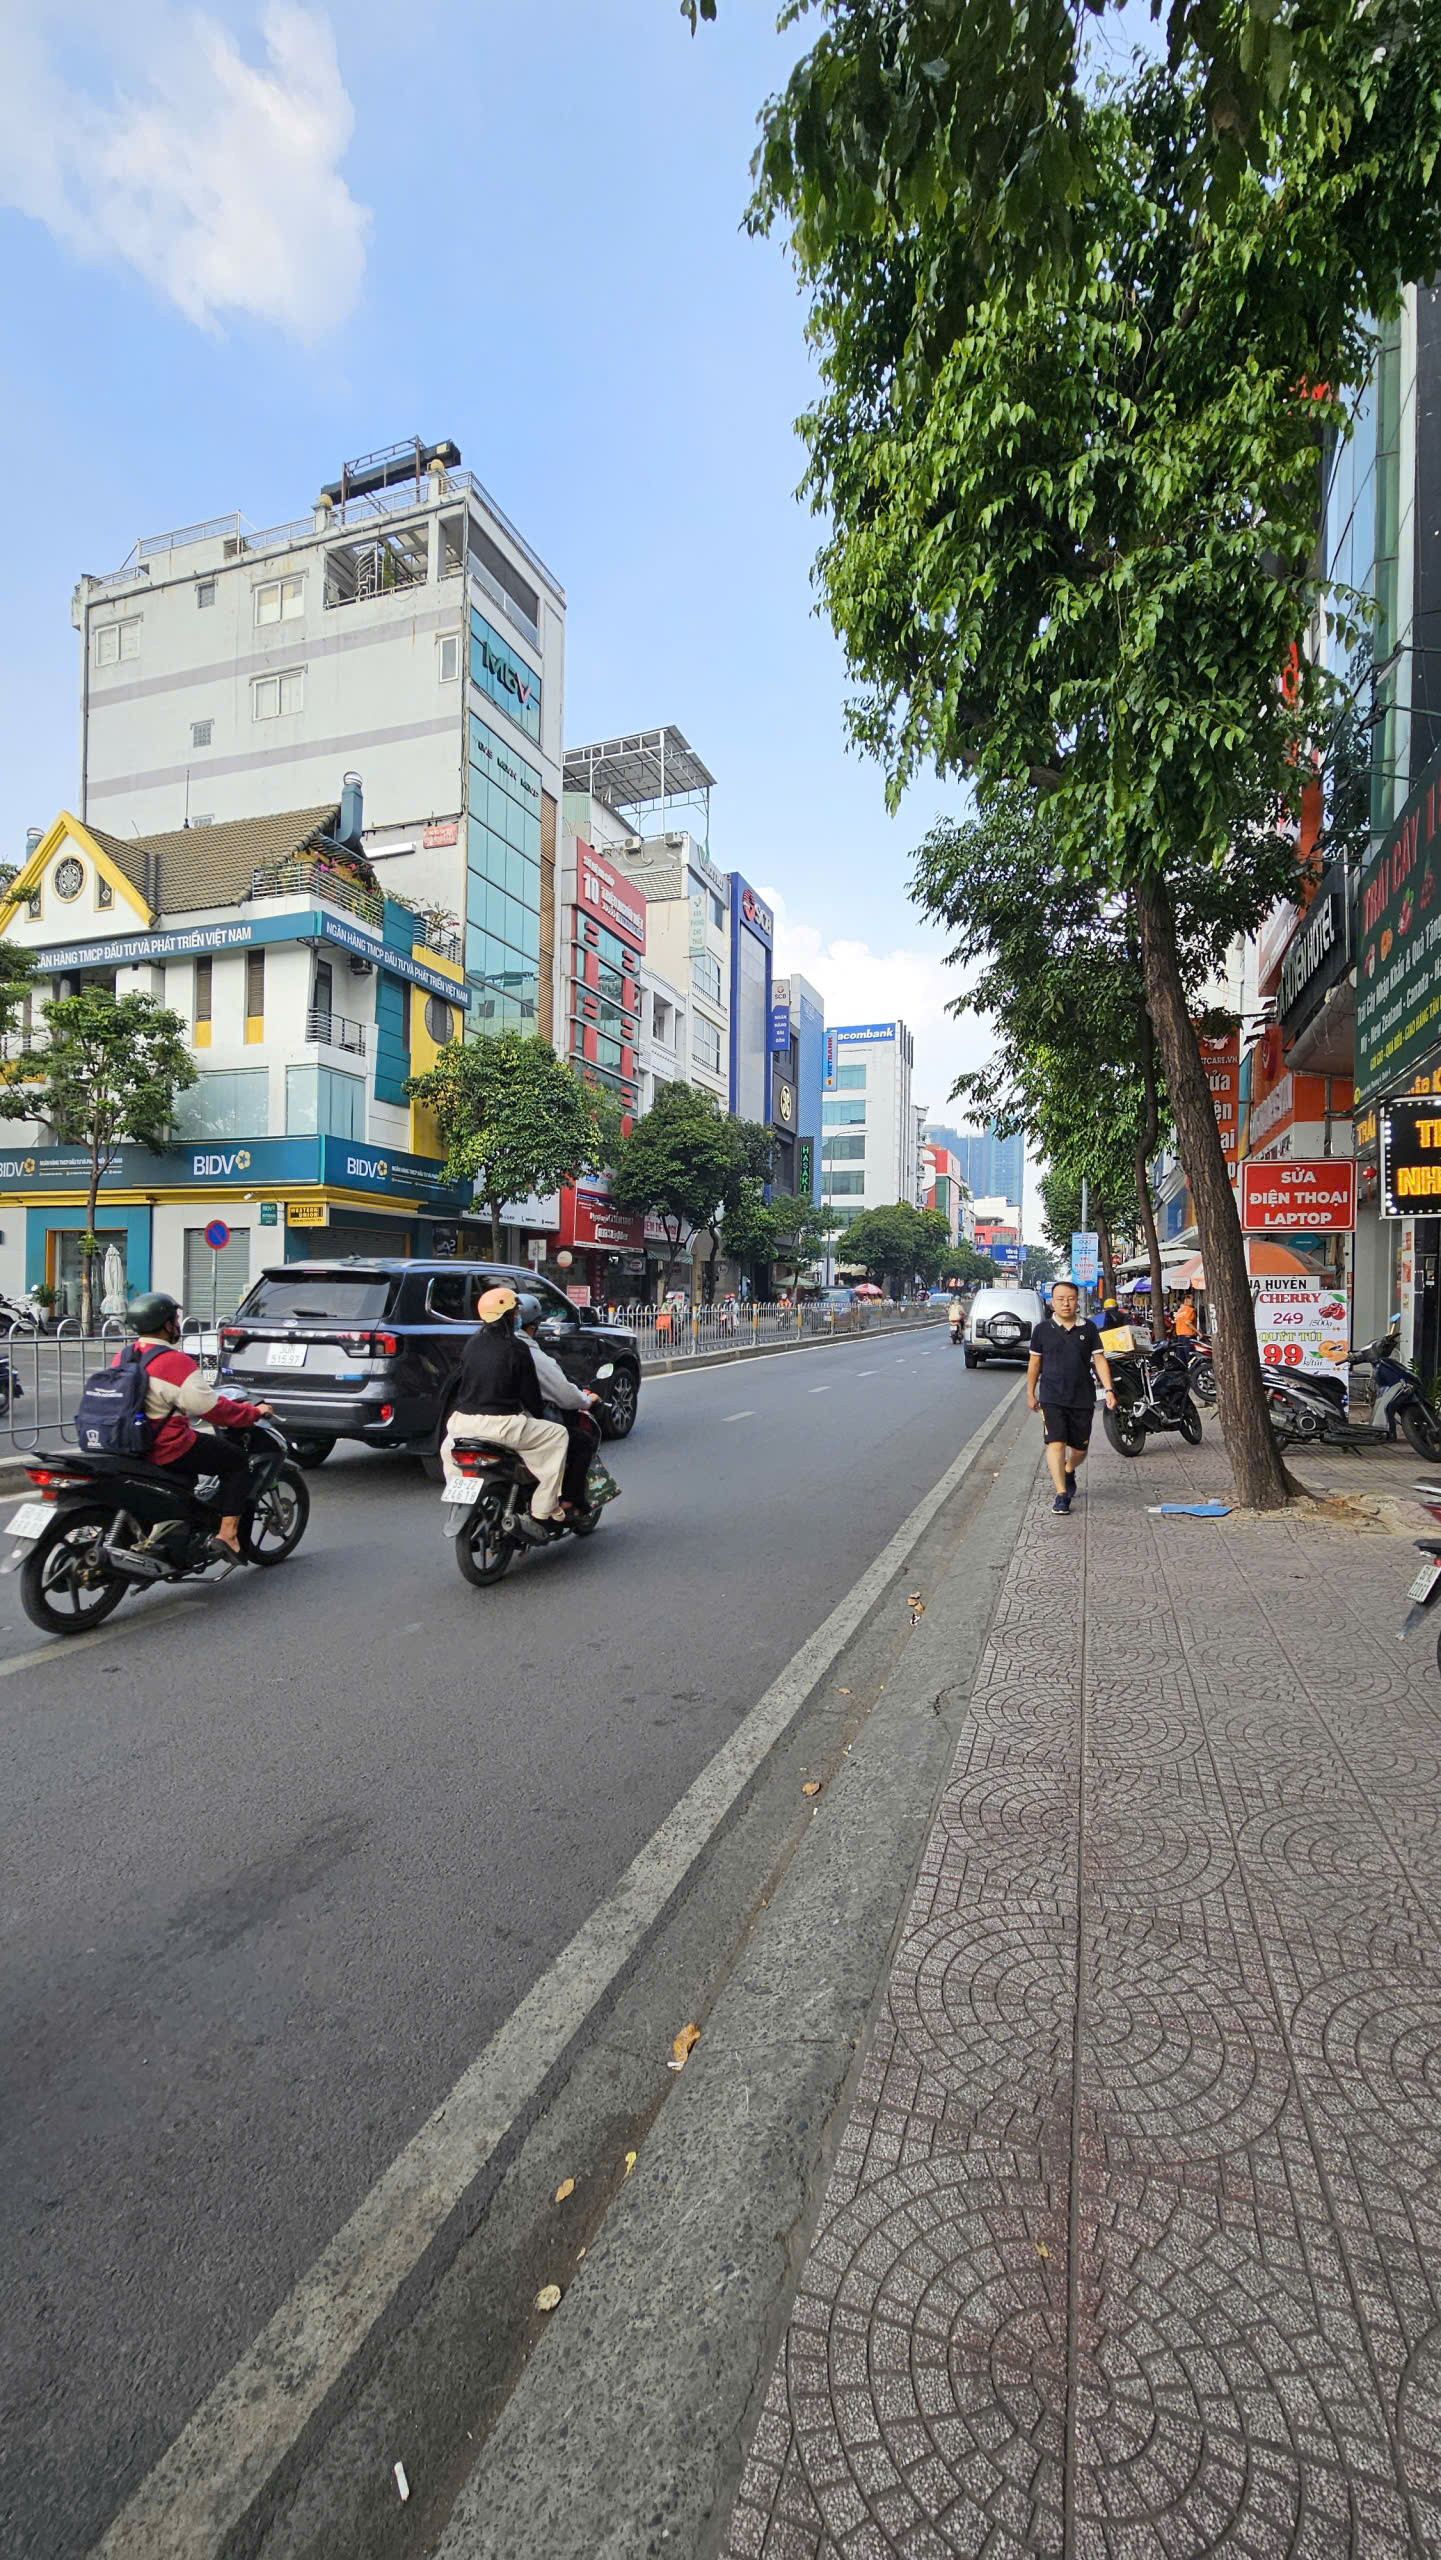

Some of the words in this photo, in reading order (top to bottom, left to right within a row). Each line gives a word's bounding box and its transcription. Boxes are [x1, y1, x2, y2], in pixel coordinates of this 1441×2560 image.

[1363, 858, 1390, 937] TRÁI
[1391, 807, 1420, 895] CÂY
[755, 903, 772, 937] SCB
[53, 950, 78, 967] HÀNG
[78, 949, 103, 963] TMCP
[104, 944, 123, 960] ĐẦU
[124, 943, 139, 956] TƯ
[138, 940, 151, 955] VÀ
[151, 936, 176, 953] PHÁT
[176, 930, 205, 949] TRIỂN
[206, 929, 228, 948] VIỆT
[228, 926, 252, 942] NAM
[1307, 893, 1335, 978] HOTEL
[327, 921, 347, 942] NGÂN
[347, 932, 366, 952] HÀNG
[367, 941, 384, 960] TMCP
[414, 966, 429, 983] PHÁT
[456, 989, 468, 1003] NAM
[1371, 1021, 1382, 1045] New
[1382, 997, 1402, 1034] Zealand
[1406, 972, 1429, 1009] Canada
[1206, 1070, 1231, 1092] ửa
[193, 1154, 236, 1176] BIDV
[347, 1157, 377, 1178] BIDV
[802, 1146, 810, 1193] HASAKI
[1281, 1167, 1316, 1184] SỬA
[1249, 1190, 1290, 1207] ĐIỆN
[1294, 1190, 1348, 1206] THOẠI
[1264, 1212, 1332, 1226] LAPTOP
[1265, 1276, 1307, 1290] HUYÊN
[1259, 1293, 1321, 1304] CHERRY
[1273, 1312, 1303, 1325] 249
[1259, 1331, 1297, 1342] QUÝT
[1298, 1331, 1323, 1342] TÚI
[1263, 1343, 1304, 1366] 99
